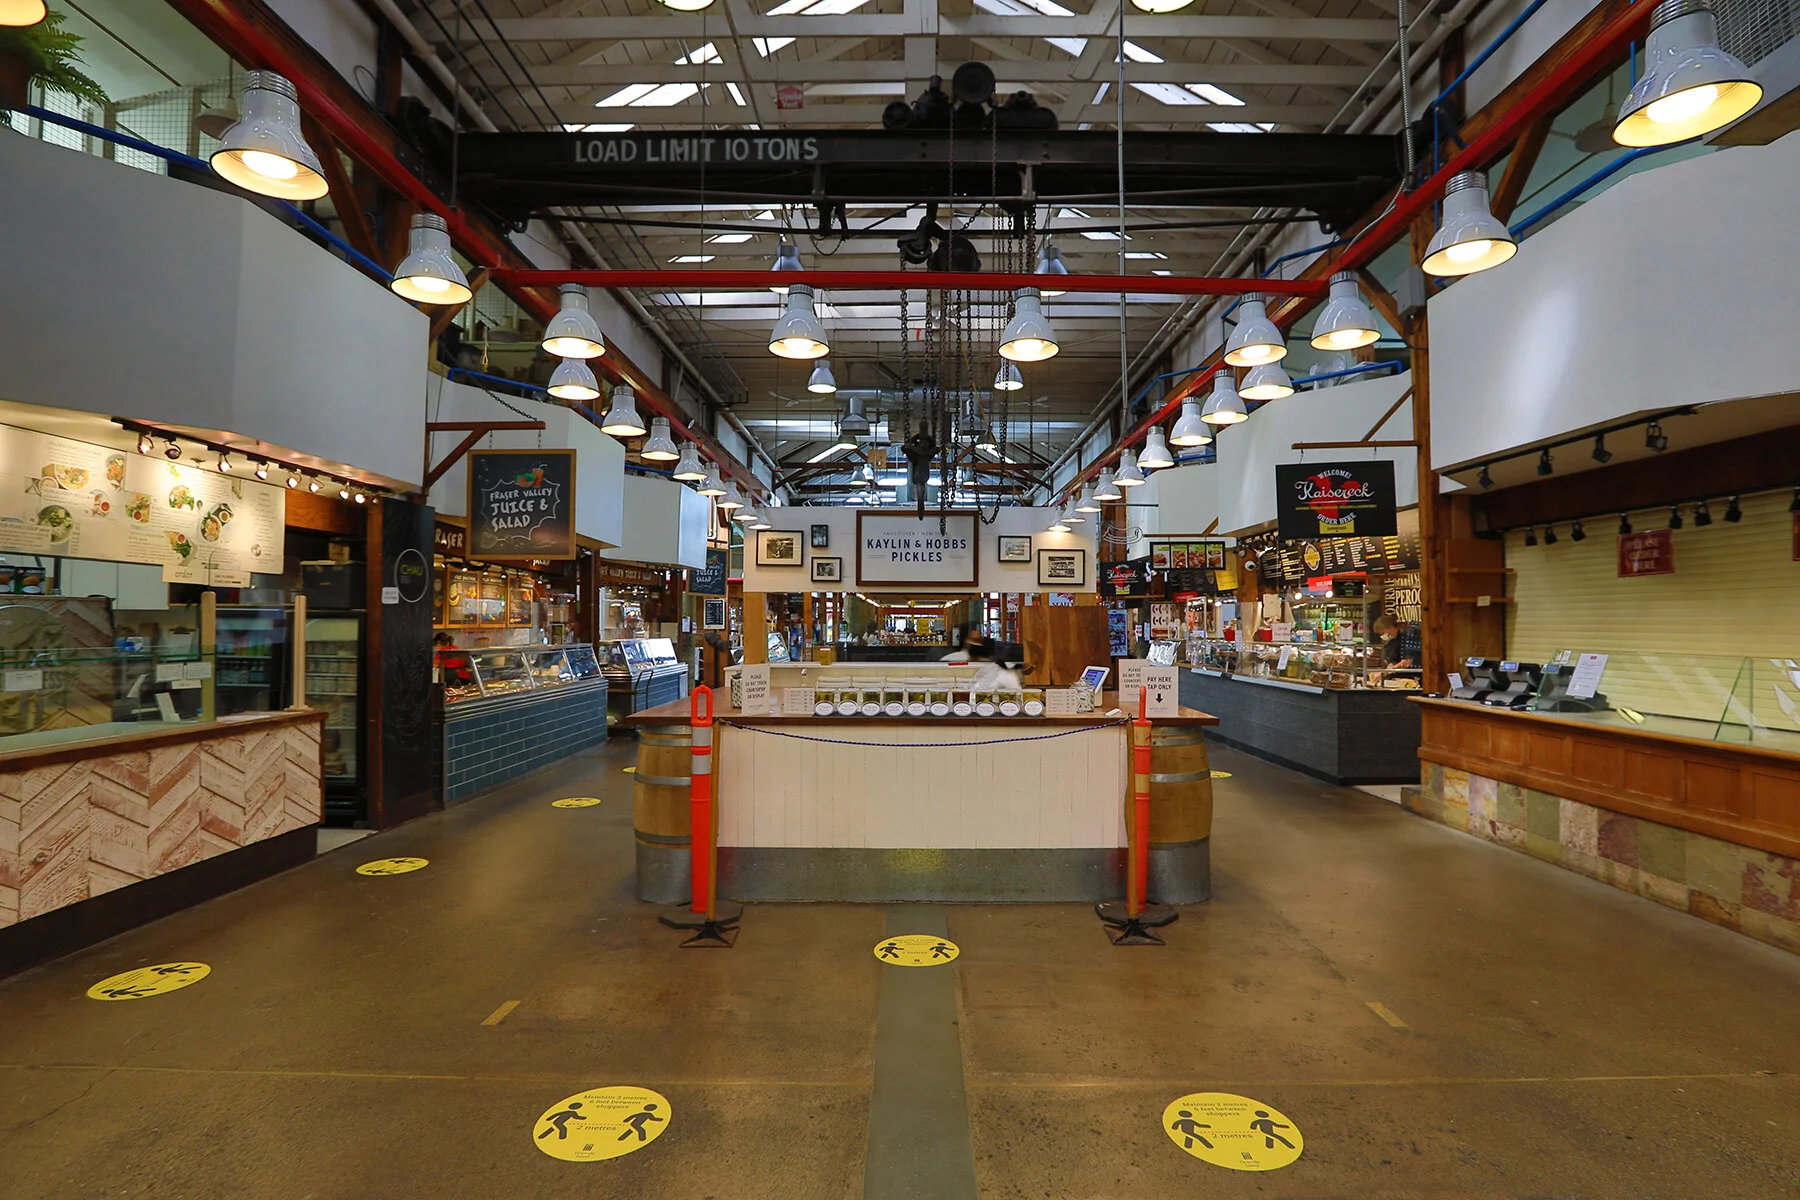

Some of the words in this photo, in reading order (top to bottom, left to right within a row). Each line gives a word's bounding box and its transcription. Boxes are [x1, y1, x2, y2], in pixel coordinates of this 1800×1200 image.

[575, 139, 637, 162] LOAD
[646, 138, 716, 162] LIMIT
[725, 138, 749, 161] 10
[753, 137, 819, 161] TONS
[1317, 469, 1352, 479] WELCOME!
[490, 489, 519, 502] FRASER
[523, 487, 552, 497] VALLEY
[1294, 481, 1375, 500] Kaisereck
[490, 499, 535, 516] JUICE
[540, 498, 548, 511] &
[491, 514, 531, 533] SALAD
[1317, 513, 1338, 525] ORDER
[1338, 511, 1357, 524] HERE
[435, 528, 463, 549] RASER
[867, 539, 911, 549] KAYLIN
[914, 540, 921, 548] &
[926, 539, 967, 549] HOBBS
[892, 552, 942, 562] PICKLES
